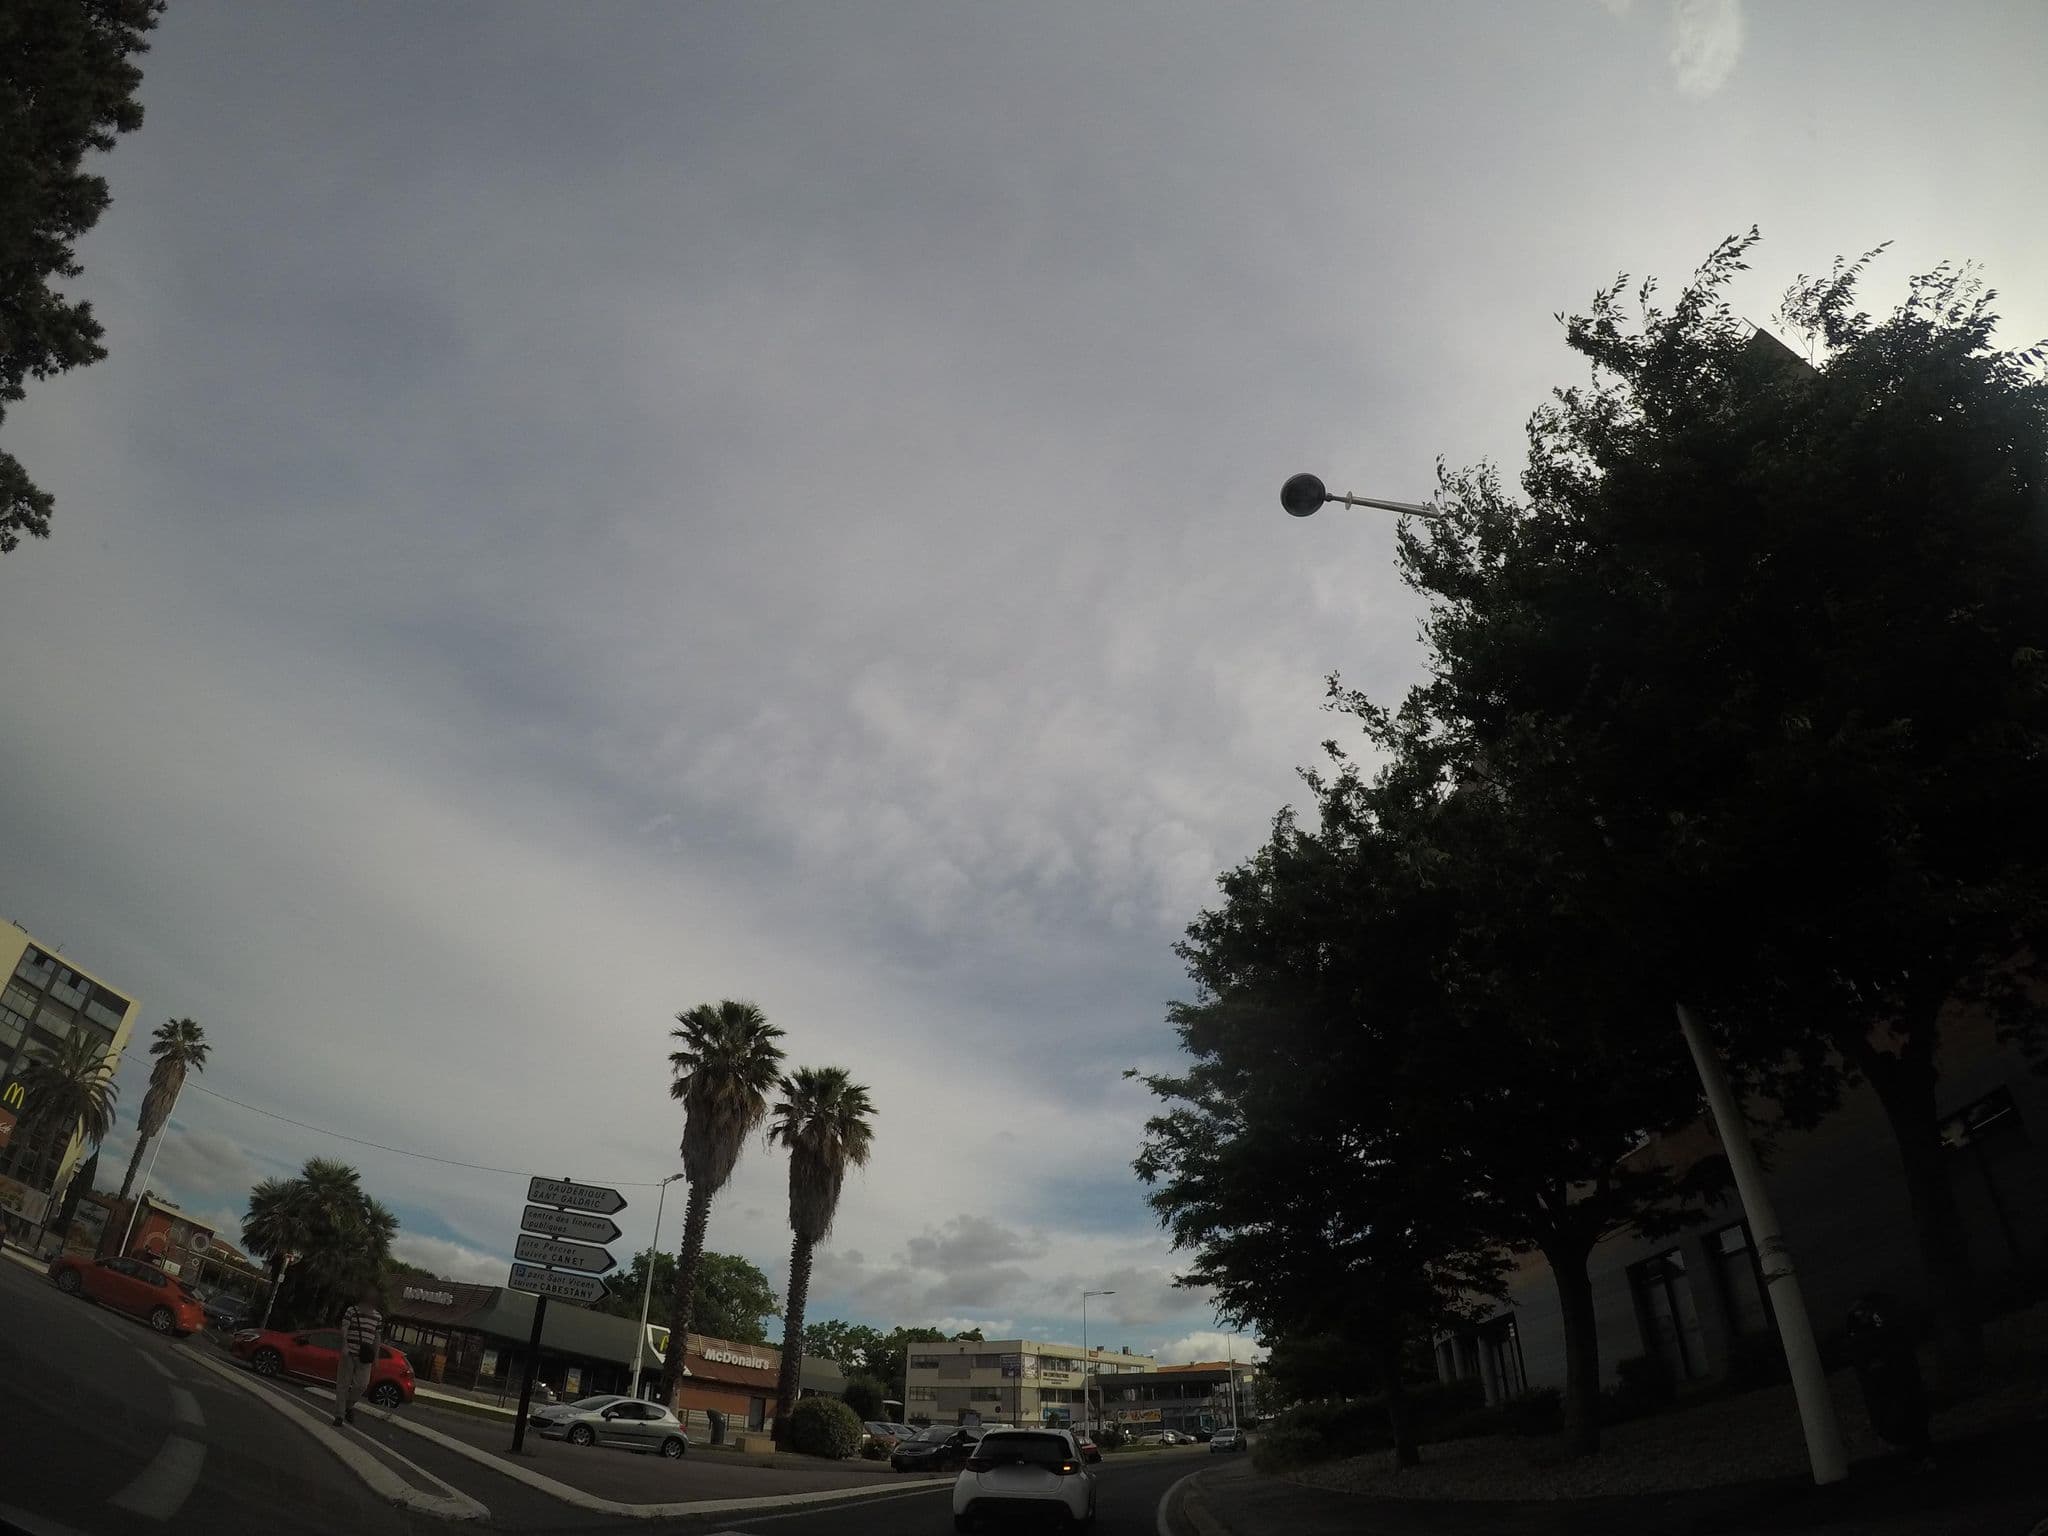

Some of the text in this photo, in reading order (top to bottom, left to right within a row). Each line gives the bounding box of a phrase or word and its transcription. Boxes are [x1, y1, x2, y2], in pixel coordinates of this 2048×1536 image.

[533, 1190, 601, 1208] SANT GALDRIC
[528, 1211, 606, 1230] centre des finances
[528, 1221, 567, 1234] publiques
[551, 1254, 585, 1266] CANET
[547, 1274, 566, 1284] Sant
[513, 1279, 594, 1299] suivre CABESTANY
[704, 1348, 770, 1370] McDonald's
